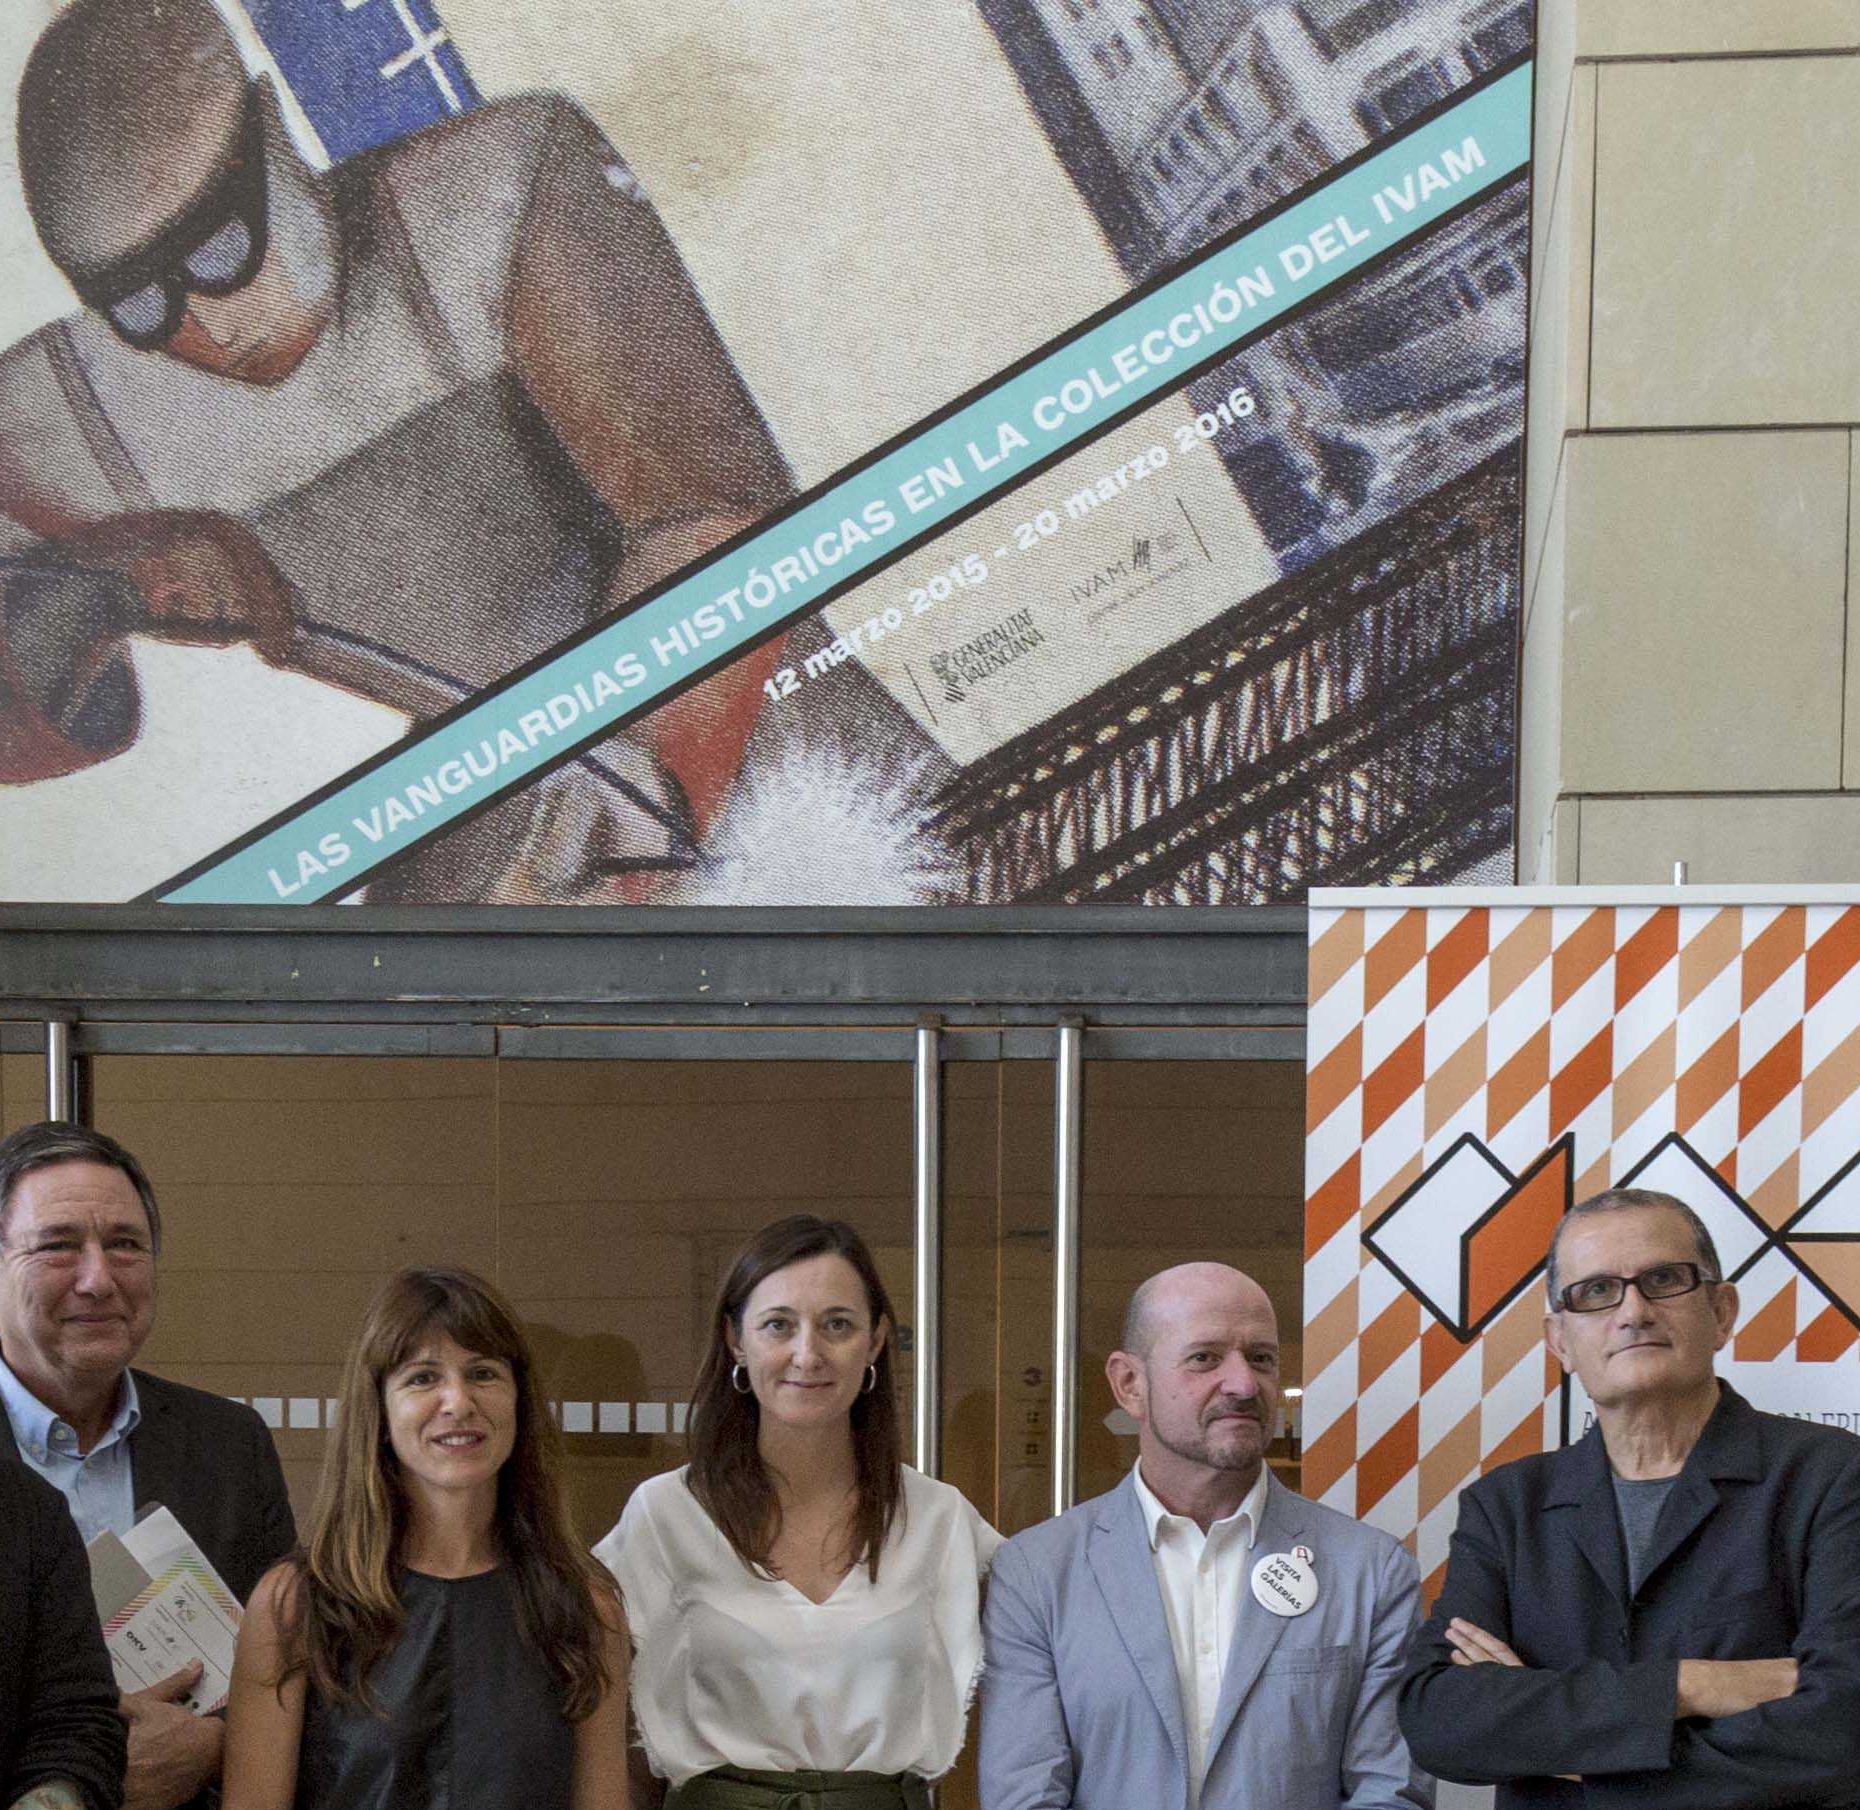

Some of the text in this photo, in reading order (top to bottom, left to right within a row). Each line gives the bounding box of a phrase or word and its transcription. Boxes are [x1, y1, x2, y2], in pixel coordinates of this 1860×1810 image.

[266, 135, 1488, 898] LAS VANGUARDIAS HISTÓRICAS EN LA COLECCIÓN DEL IVAM
[762, 667, 802, 704] 12
[803, 607, 903, 679] marzo
[907, 552, 989, 618] 2015
[1012, 509, 1060, 552] 20
[1062, 443, 1170, 521] marzo
[1173, 386, 1256, 455] 2016
[1069, 560, 1128, 604] IVAM
[1267, 1564, 1285, 1581] LAS
[1275, 1556, 1302, 1583] VISITA
